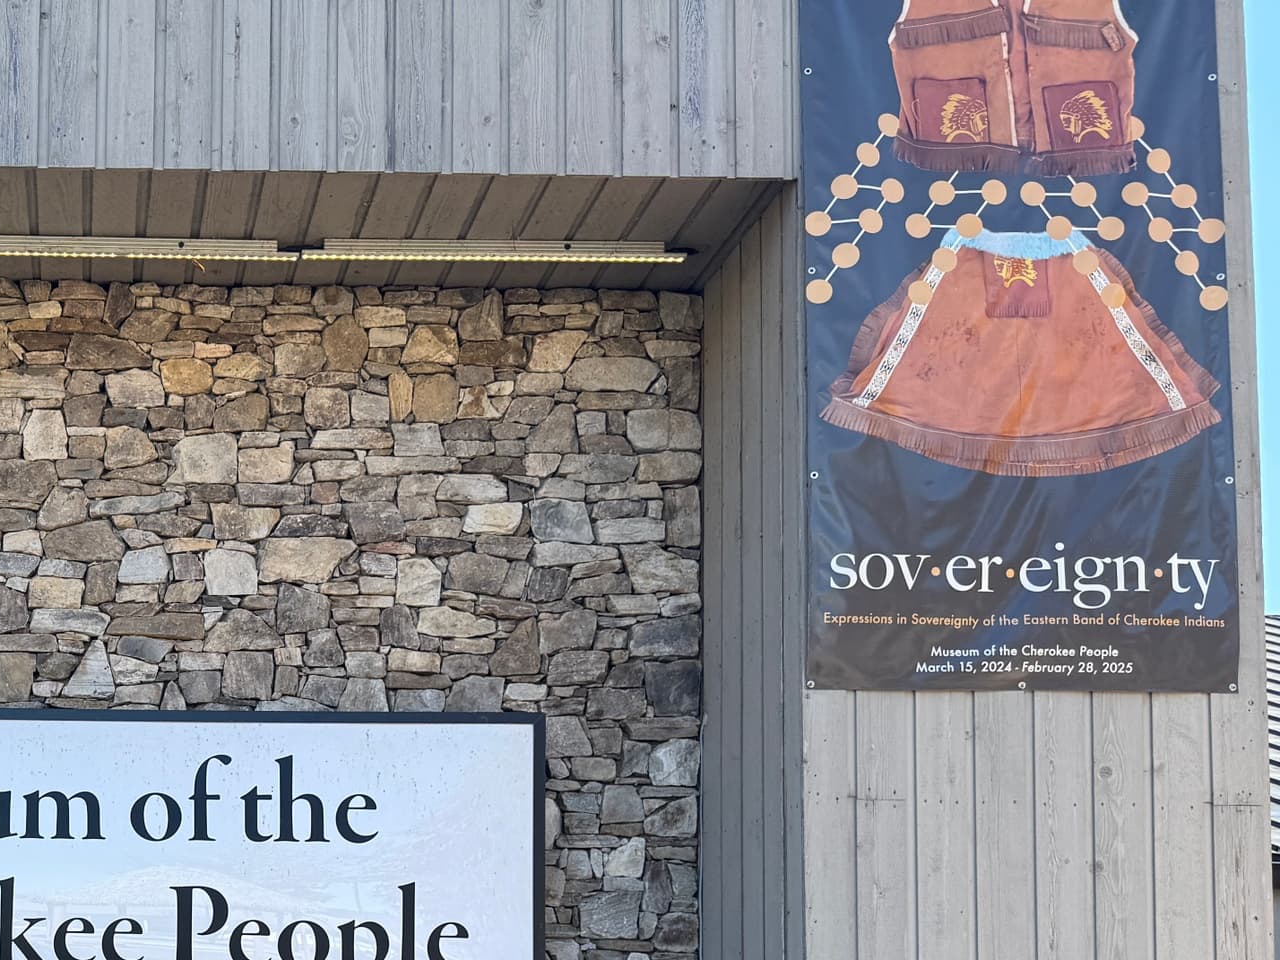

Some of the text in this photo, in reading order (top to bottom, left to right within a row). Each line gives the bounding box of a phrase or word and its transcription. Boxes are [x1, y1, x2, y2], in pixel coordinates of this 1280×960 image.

[823, 611, 1226, 630] Expressions in Sovereignty of the Eastern Band of Cherokee Indians
[930, 644, 1119, 660] Museum of the Cherokee People
[915, 660, 955, 674] March
[959, 661, 977, 674] 15,
[981, 661, 1012, 673] 2024
[1021, 660, 1075, 676] February
[1077, 661, 1098, 675] 28,
[1101, 661, 1133, 674] 2025
[129, 754, 232, 843] of
[240, 754, 379, 844] the
